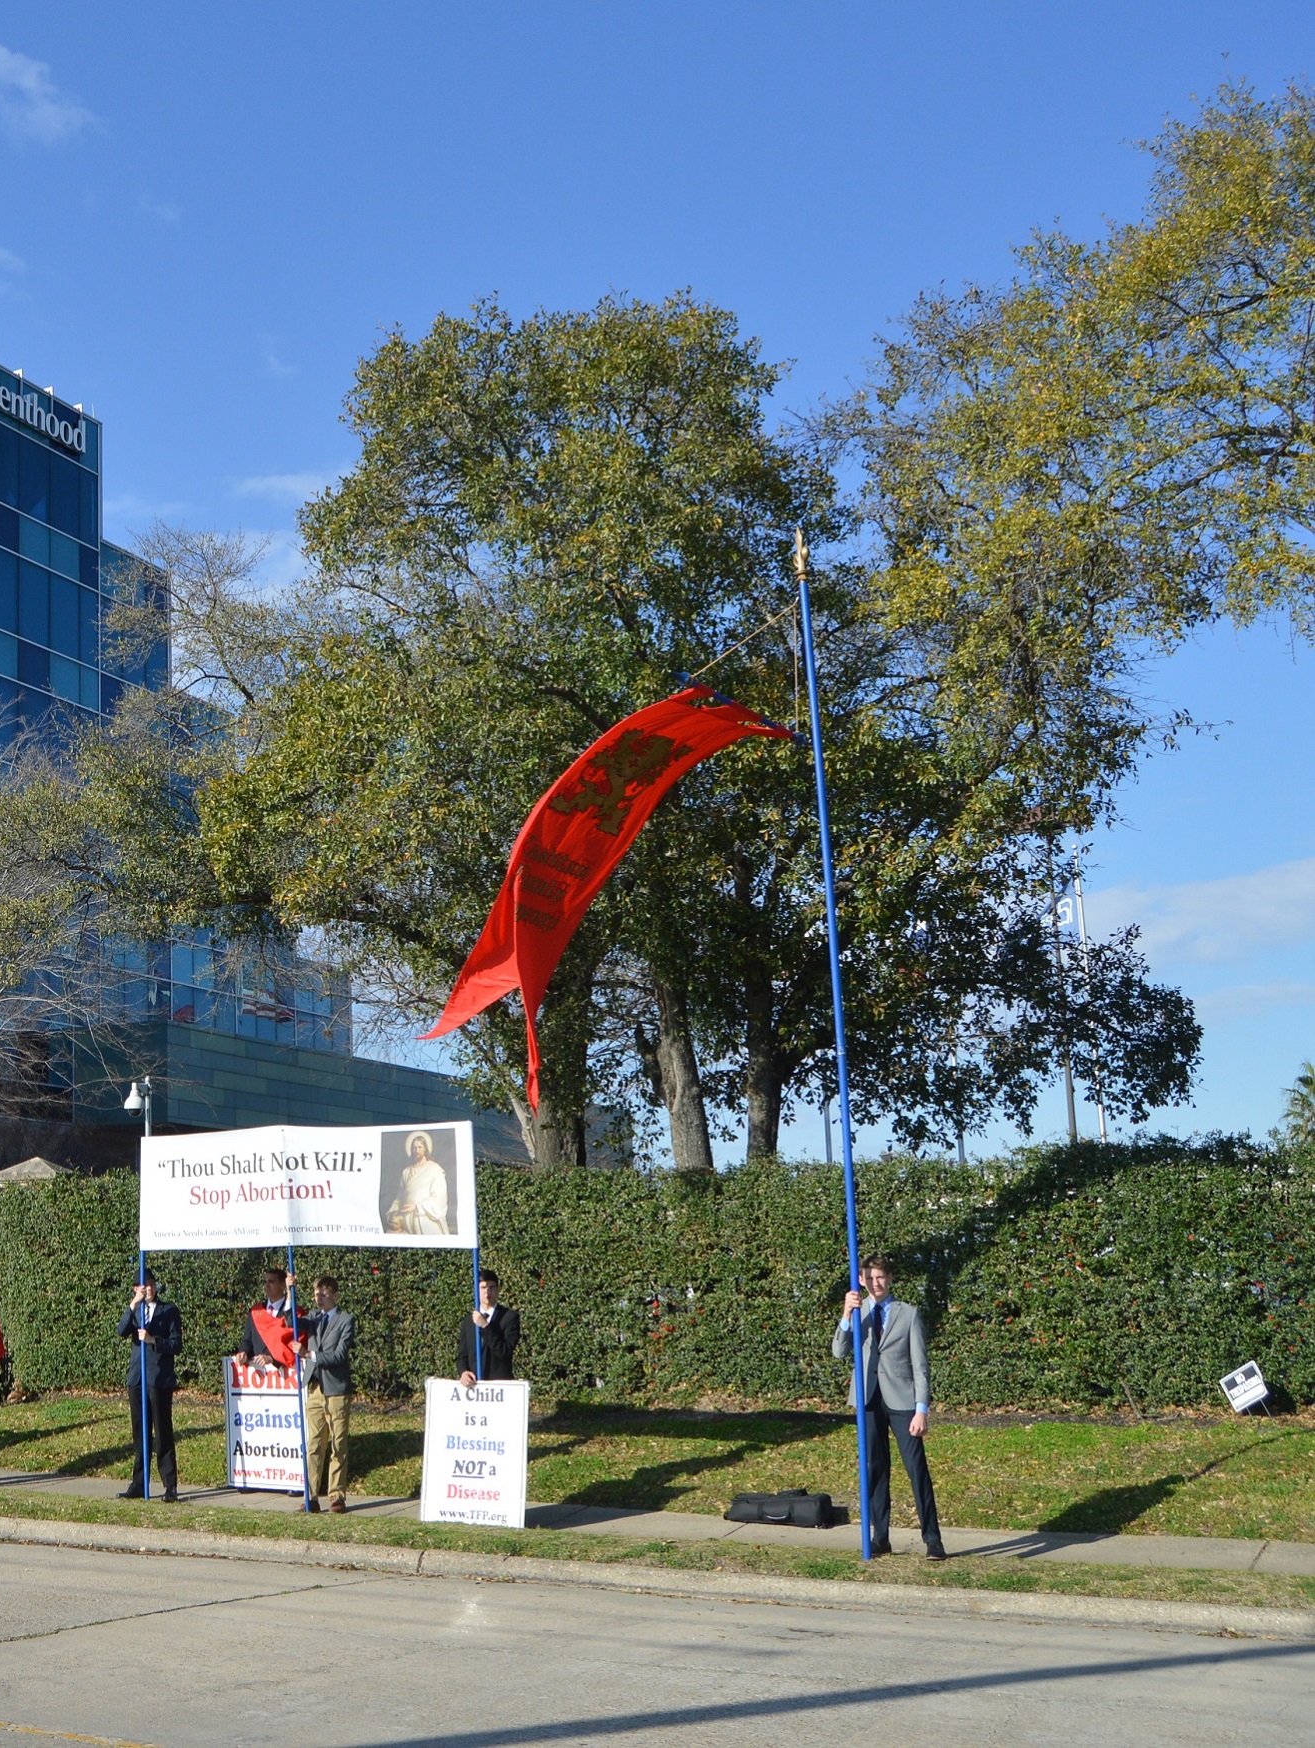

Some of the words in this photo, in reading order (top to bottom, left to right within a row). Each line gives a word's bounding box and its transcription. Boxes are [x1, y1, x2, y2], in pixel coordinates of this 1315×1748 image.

[158, 1158, 214, 1178] “Thou
[220, 1153, 266, 1175] Shalt
[271, 1151, 310, 1172] Not
[313, 1151, 373, 1173] Kill.”
[189, 1185, 230, 1210] Stop
[236, 1178, 333, 1203] Abortion!
[183, 1229, 204, 1238] Needs
[325, 1224, 341, 1233] TFP
[348, 1224, 380, 1235] TFP.org
[231, 1361, 299, 1390] Honk
[1234, 1372, 1246, 1385] NO
[450, 1387, 461, 1401] A
[465, 1387, 504, 1402] Child
[233, 1408, 302, 1432] against
[465, 1412, 476, 1426] is
[480, 1415, 488, 1426] a
[446, 1435, 505, 1455] Blessing
[453, 1460, 487, 1475] NOT
[489, 1465, 497, 1476] a
[446, 1483, 501, 1501] Disease
[439, 1508, 507, 1524] www.TFP.org
